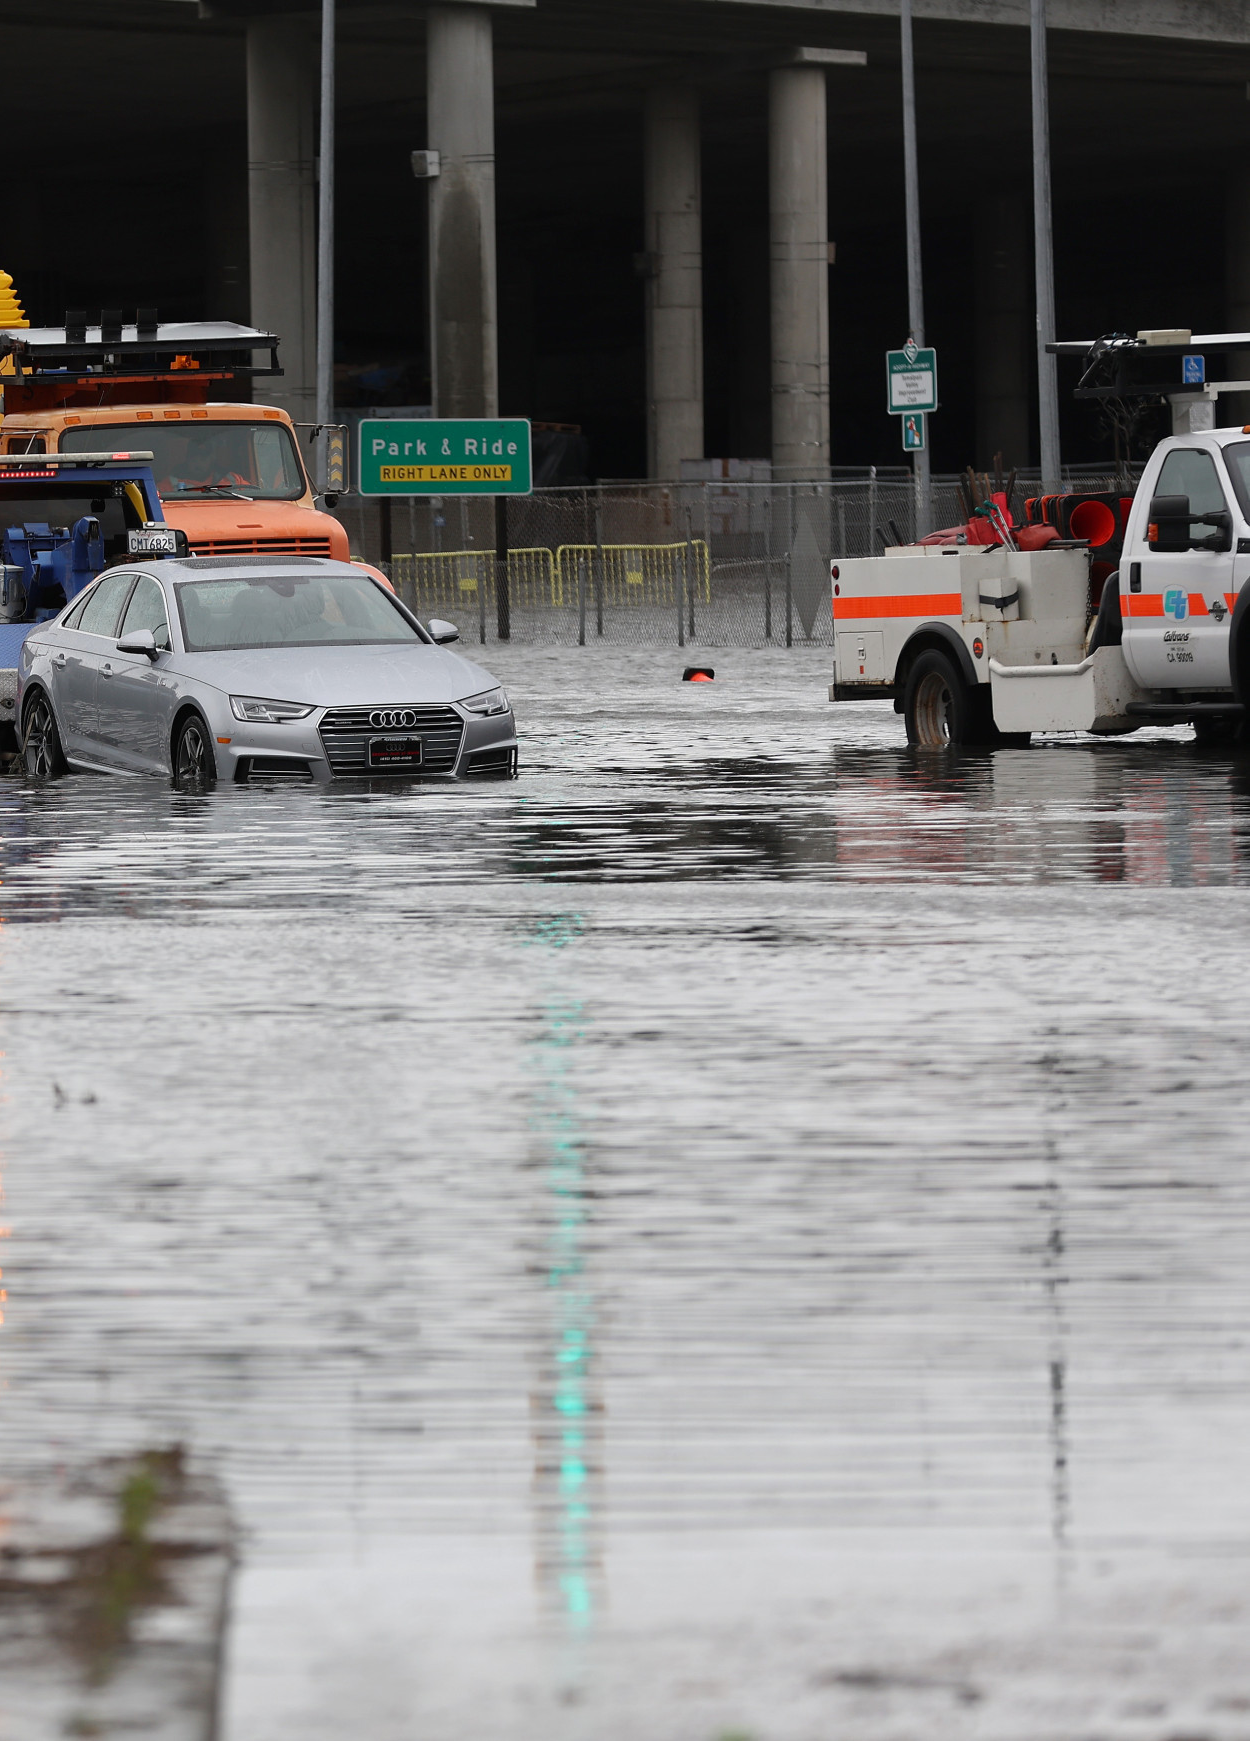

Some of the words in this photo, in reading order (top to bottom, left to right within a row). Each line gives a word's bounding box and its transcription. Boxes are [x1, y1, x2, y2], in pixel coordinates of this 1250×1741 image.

[372, 438, 428, 456] Park
[441, 438, 451, 456] &
[464, 438, 518, 456] Ride
[383, 467, 423, 479] RIGHT
[430, 467, 467, 479] LANE
[474, 467, 508, 479] ONLY
